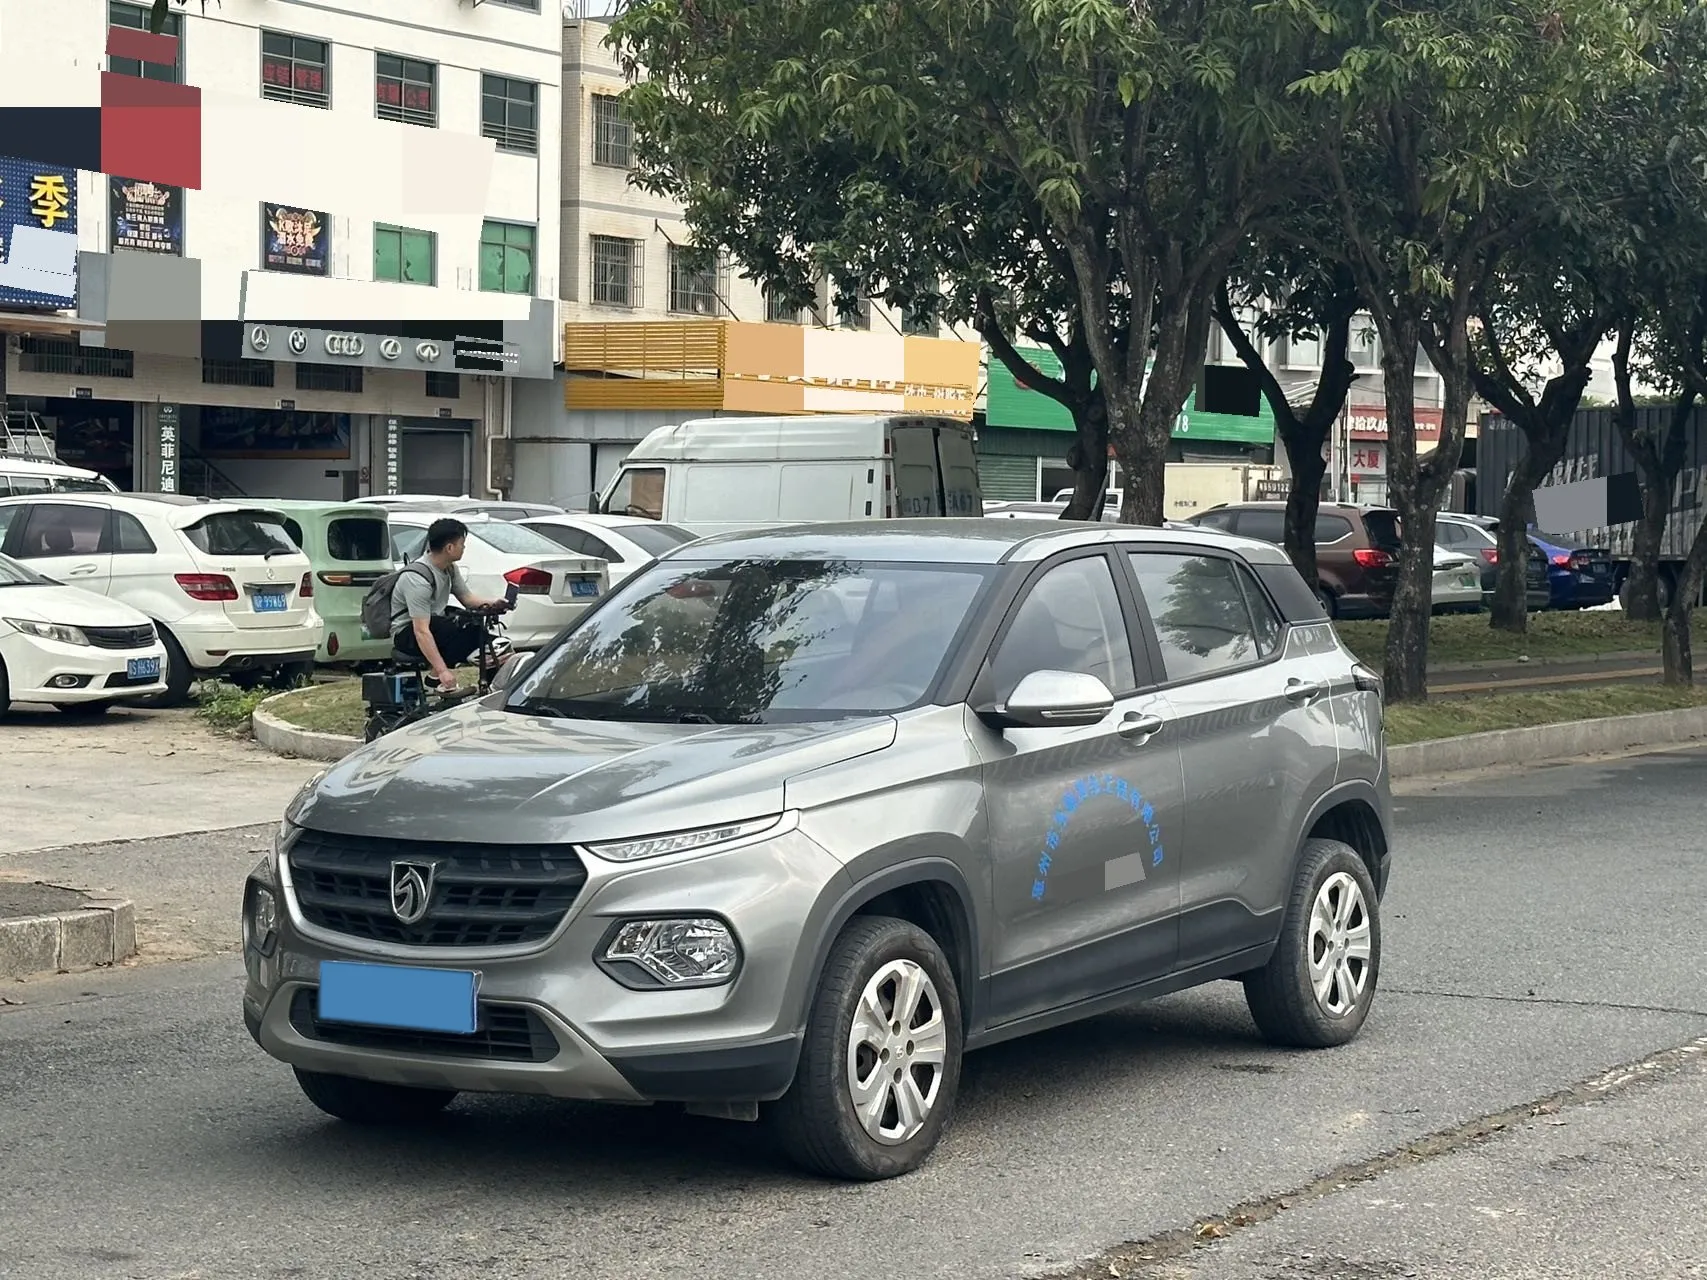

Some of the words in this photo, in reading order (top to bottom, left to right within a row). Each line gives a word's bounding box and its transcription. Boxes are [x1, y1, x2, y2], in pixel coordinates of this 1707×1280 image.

[29, 175, 70, 228] 季
[160, 425, 176, 492] 英菲尼迪
[1353, 449, 1380, 469] 大厦
